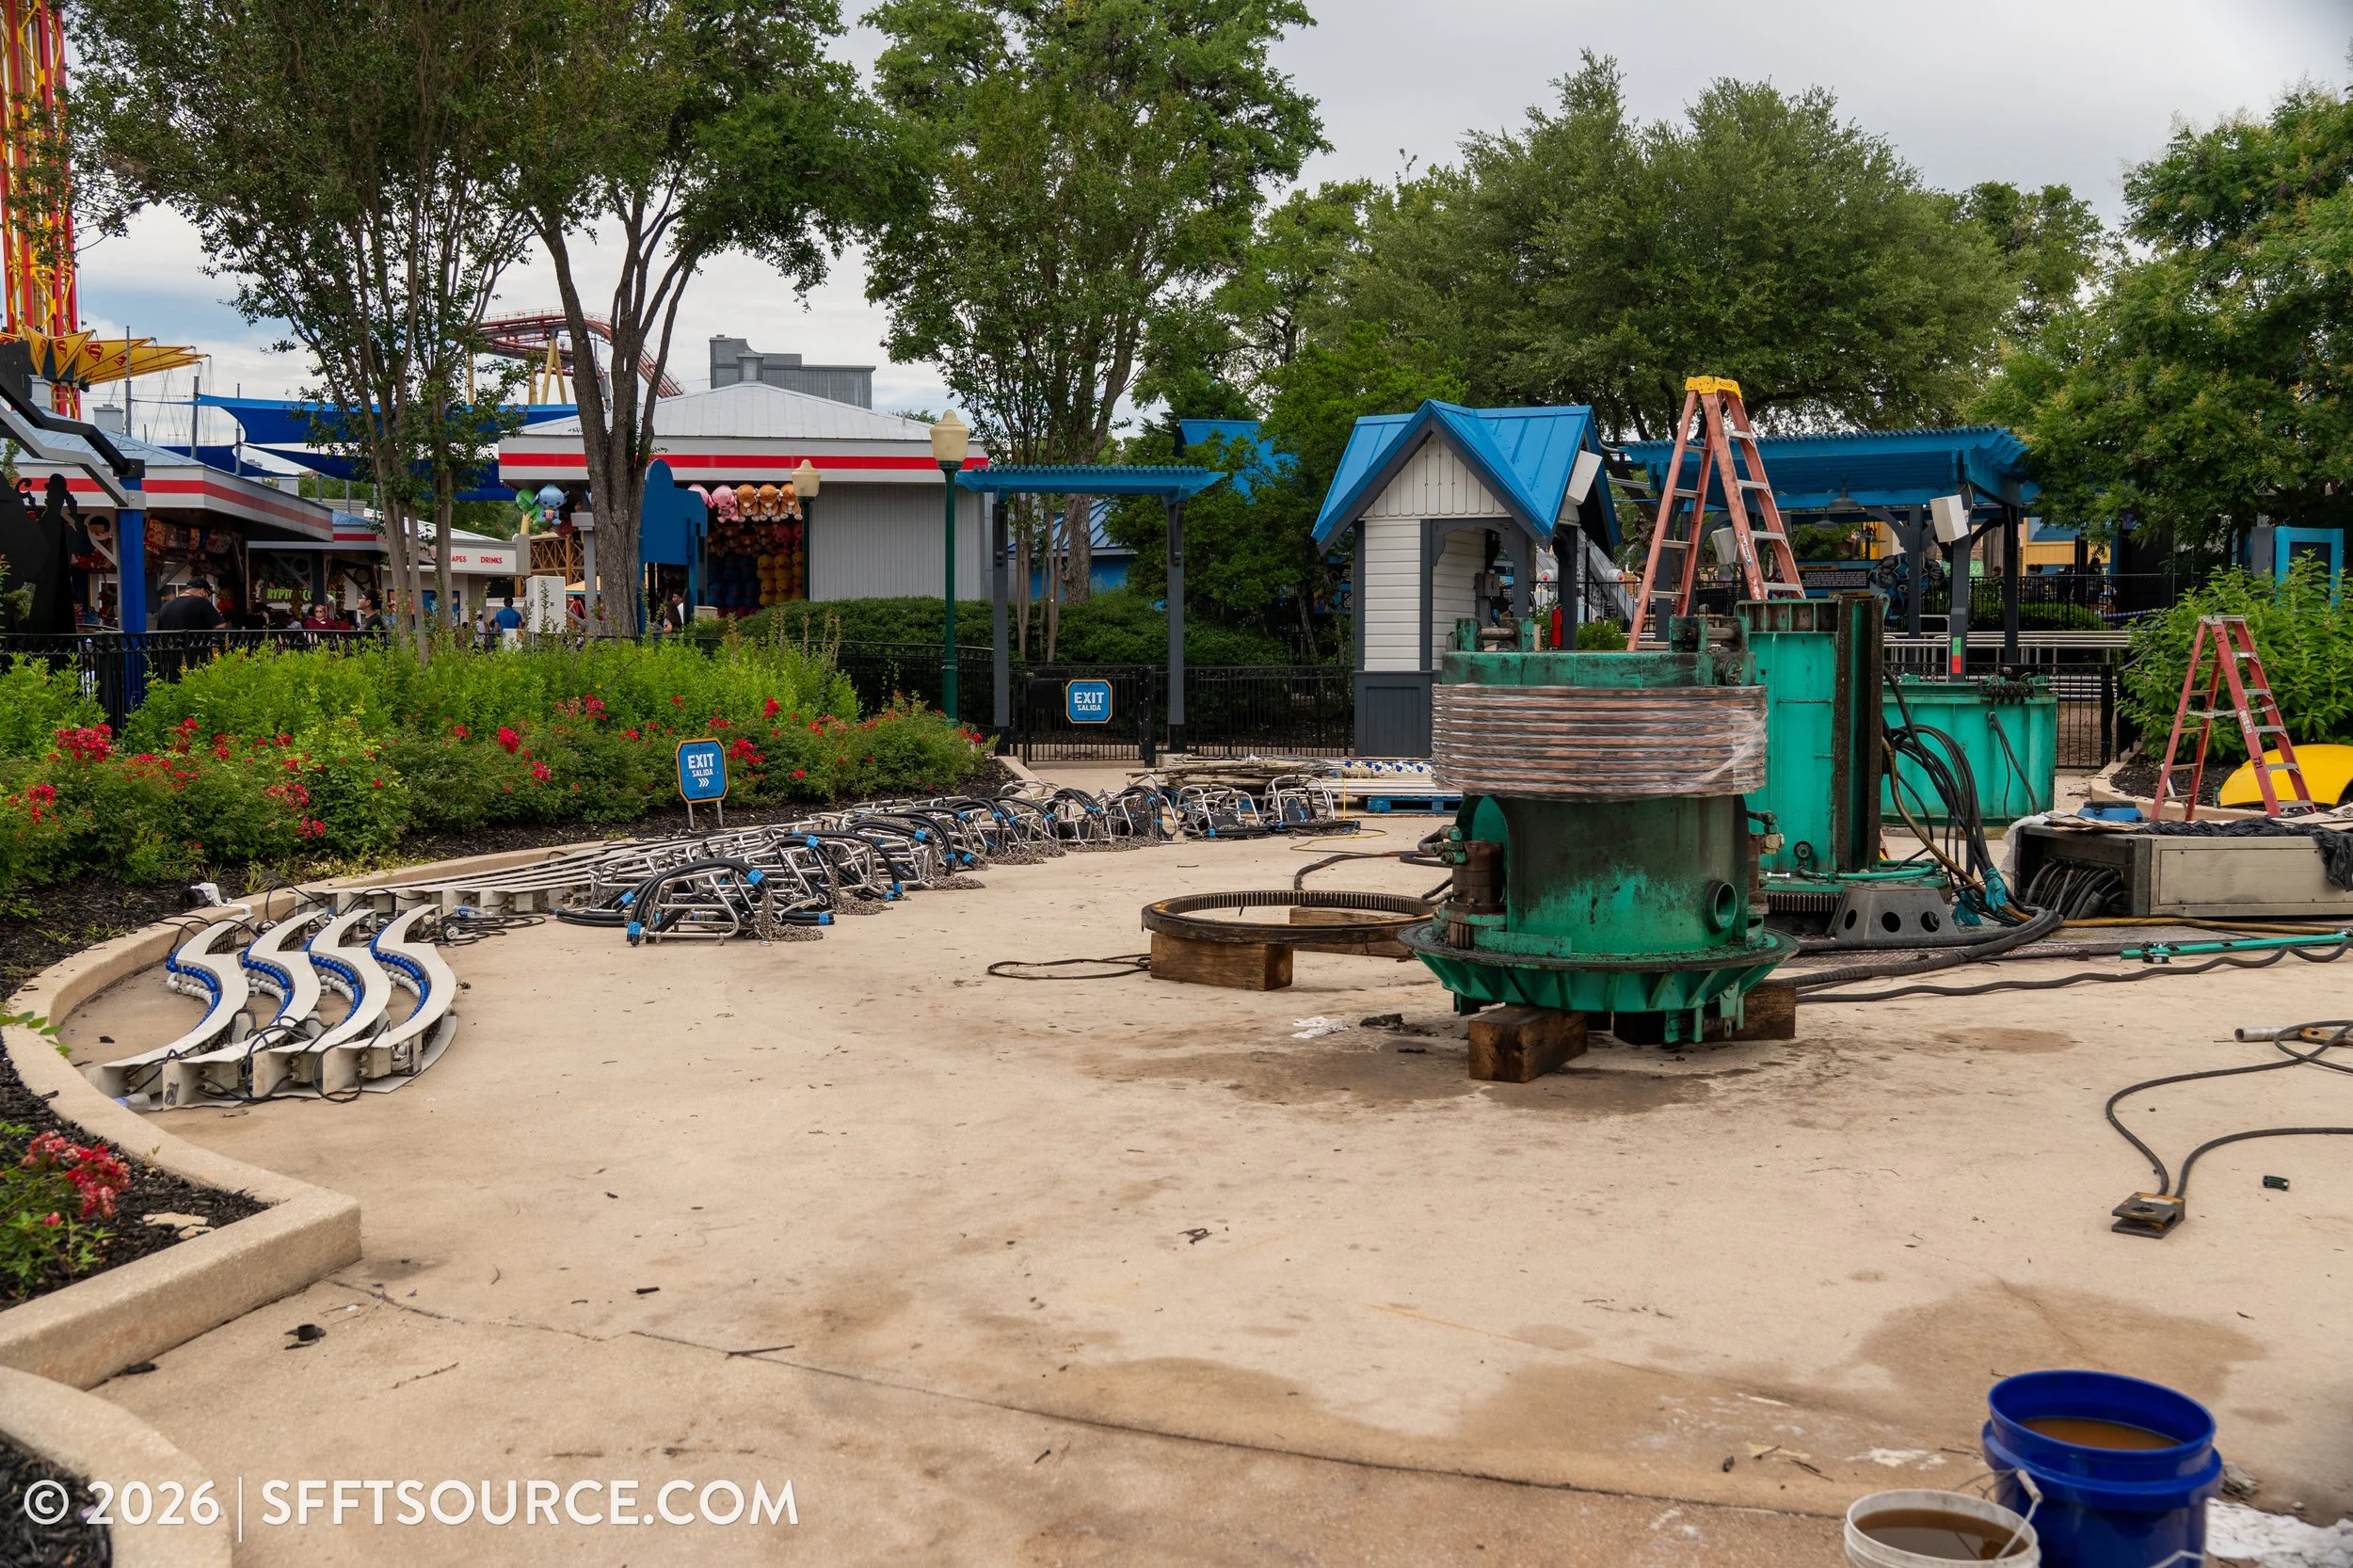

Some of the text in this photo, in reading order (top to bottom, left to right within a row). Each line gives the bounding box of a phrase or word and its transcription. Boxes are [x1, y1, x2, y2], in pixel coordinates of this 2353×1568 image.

[1074, 692, 1105, 704] EXIT
[687, 753, 714, 769] EXIT
[2252, 756, 2264, 769] 721
[692, 768, 714, 777] SALIDA
